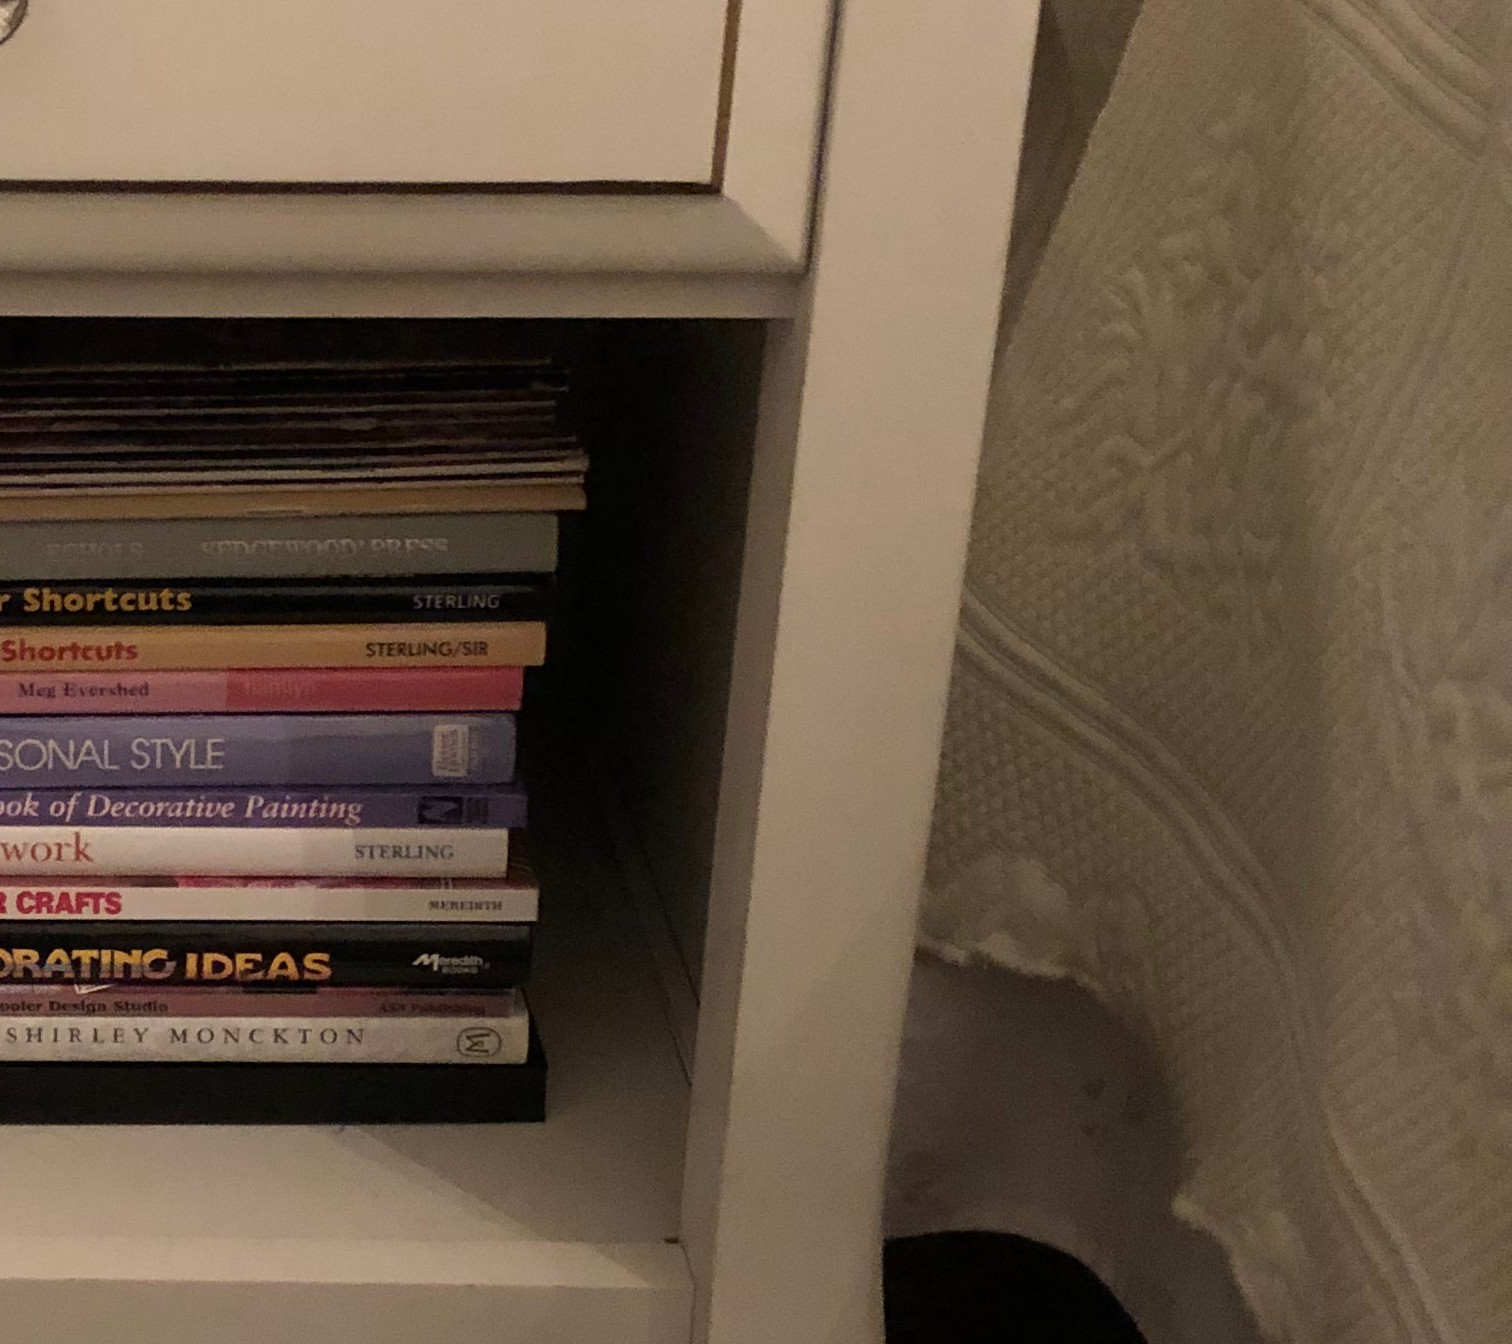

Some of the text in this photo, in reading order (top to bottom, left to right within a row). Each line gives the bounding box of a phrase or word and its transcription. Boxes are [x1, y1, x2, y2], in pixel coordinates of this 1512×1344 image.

[23, 587, 192, 613] Shortcuts
[412, 593, 501, 610] STERLING
[0, 639, 138, 662] Shortcuts
[365, 639, 489, 659] STERLING/SIR
[18, 681, 56, 700] Meg
[130, 737, 225, 771] STYLE
[49, 793, 80, 823] of
[87, 794, 235, 820] Decorative
[245, 795, 363, 826] Painting
[354, 844, 455, 860] STERLING
[15, 891, 123, 915] CRAFTS
[429, 898, 503, 912] MEREDITH
[185, 952, 332, 982] IDEAS
[412, 953, 484, 972] Meredith
[49, 1000, 108, 1016] Design
[113, 1000, 168, 1013] Studio
[6, 1027, 366, 1045] SHIRLEY MONCKTON
